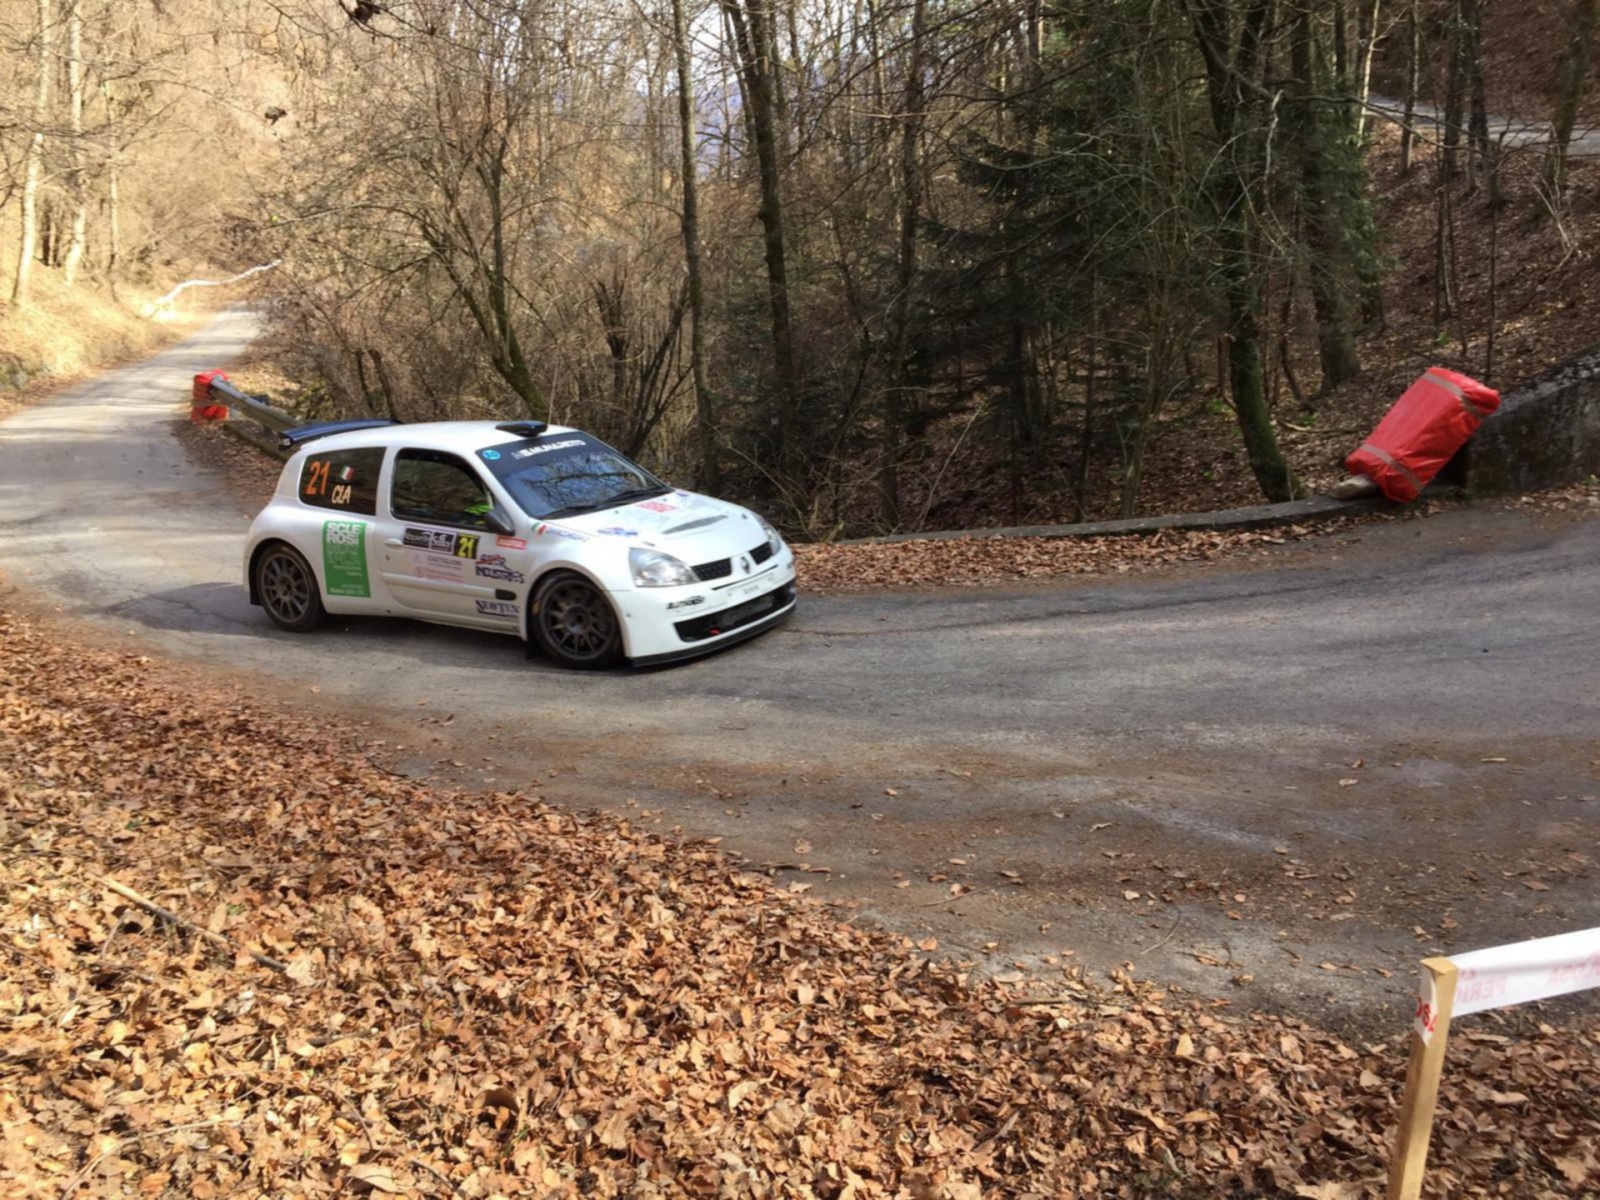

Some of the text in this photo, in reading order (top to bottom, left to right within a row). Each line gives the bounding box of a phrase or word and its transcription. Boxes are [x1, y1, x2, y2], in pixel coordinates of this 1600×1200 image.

[306, 460, 331, 495] 21
[331, 484, 352, 504] CLA
[327, 522, 361, 535] SCLE
[326, 533, 359, 545] ROSI
[458, 537, 475, 558] 21
